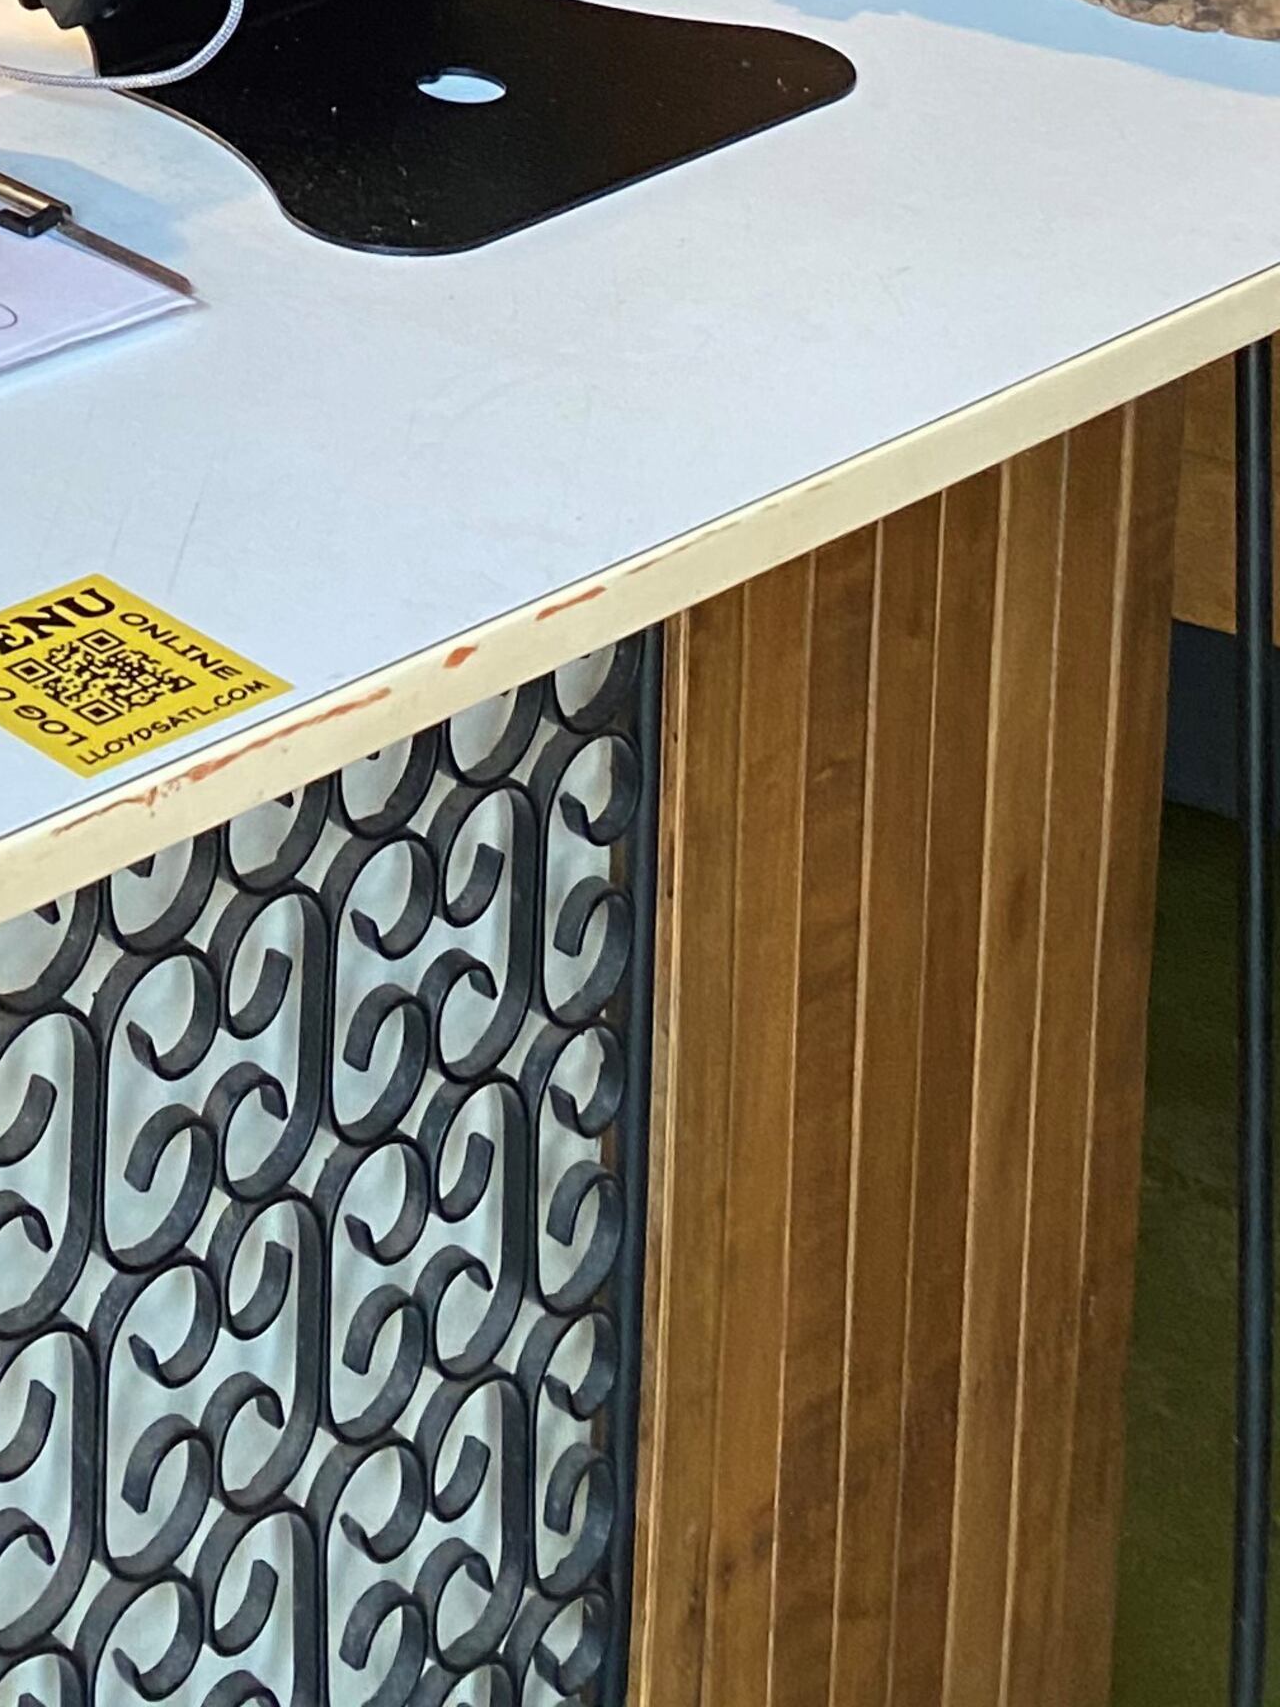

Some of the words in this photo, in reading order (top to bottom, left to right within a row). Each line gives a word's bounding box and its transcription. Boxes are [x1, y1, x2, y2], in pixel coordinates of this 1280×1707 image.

[118, 611, 243, 682] ONLINE
[14, 703, 87, 747] LOG
[77, 679, 271, 765] LLOYDSATL.COM
